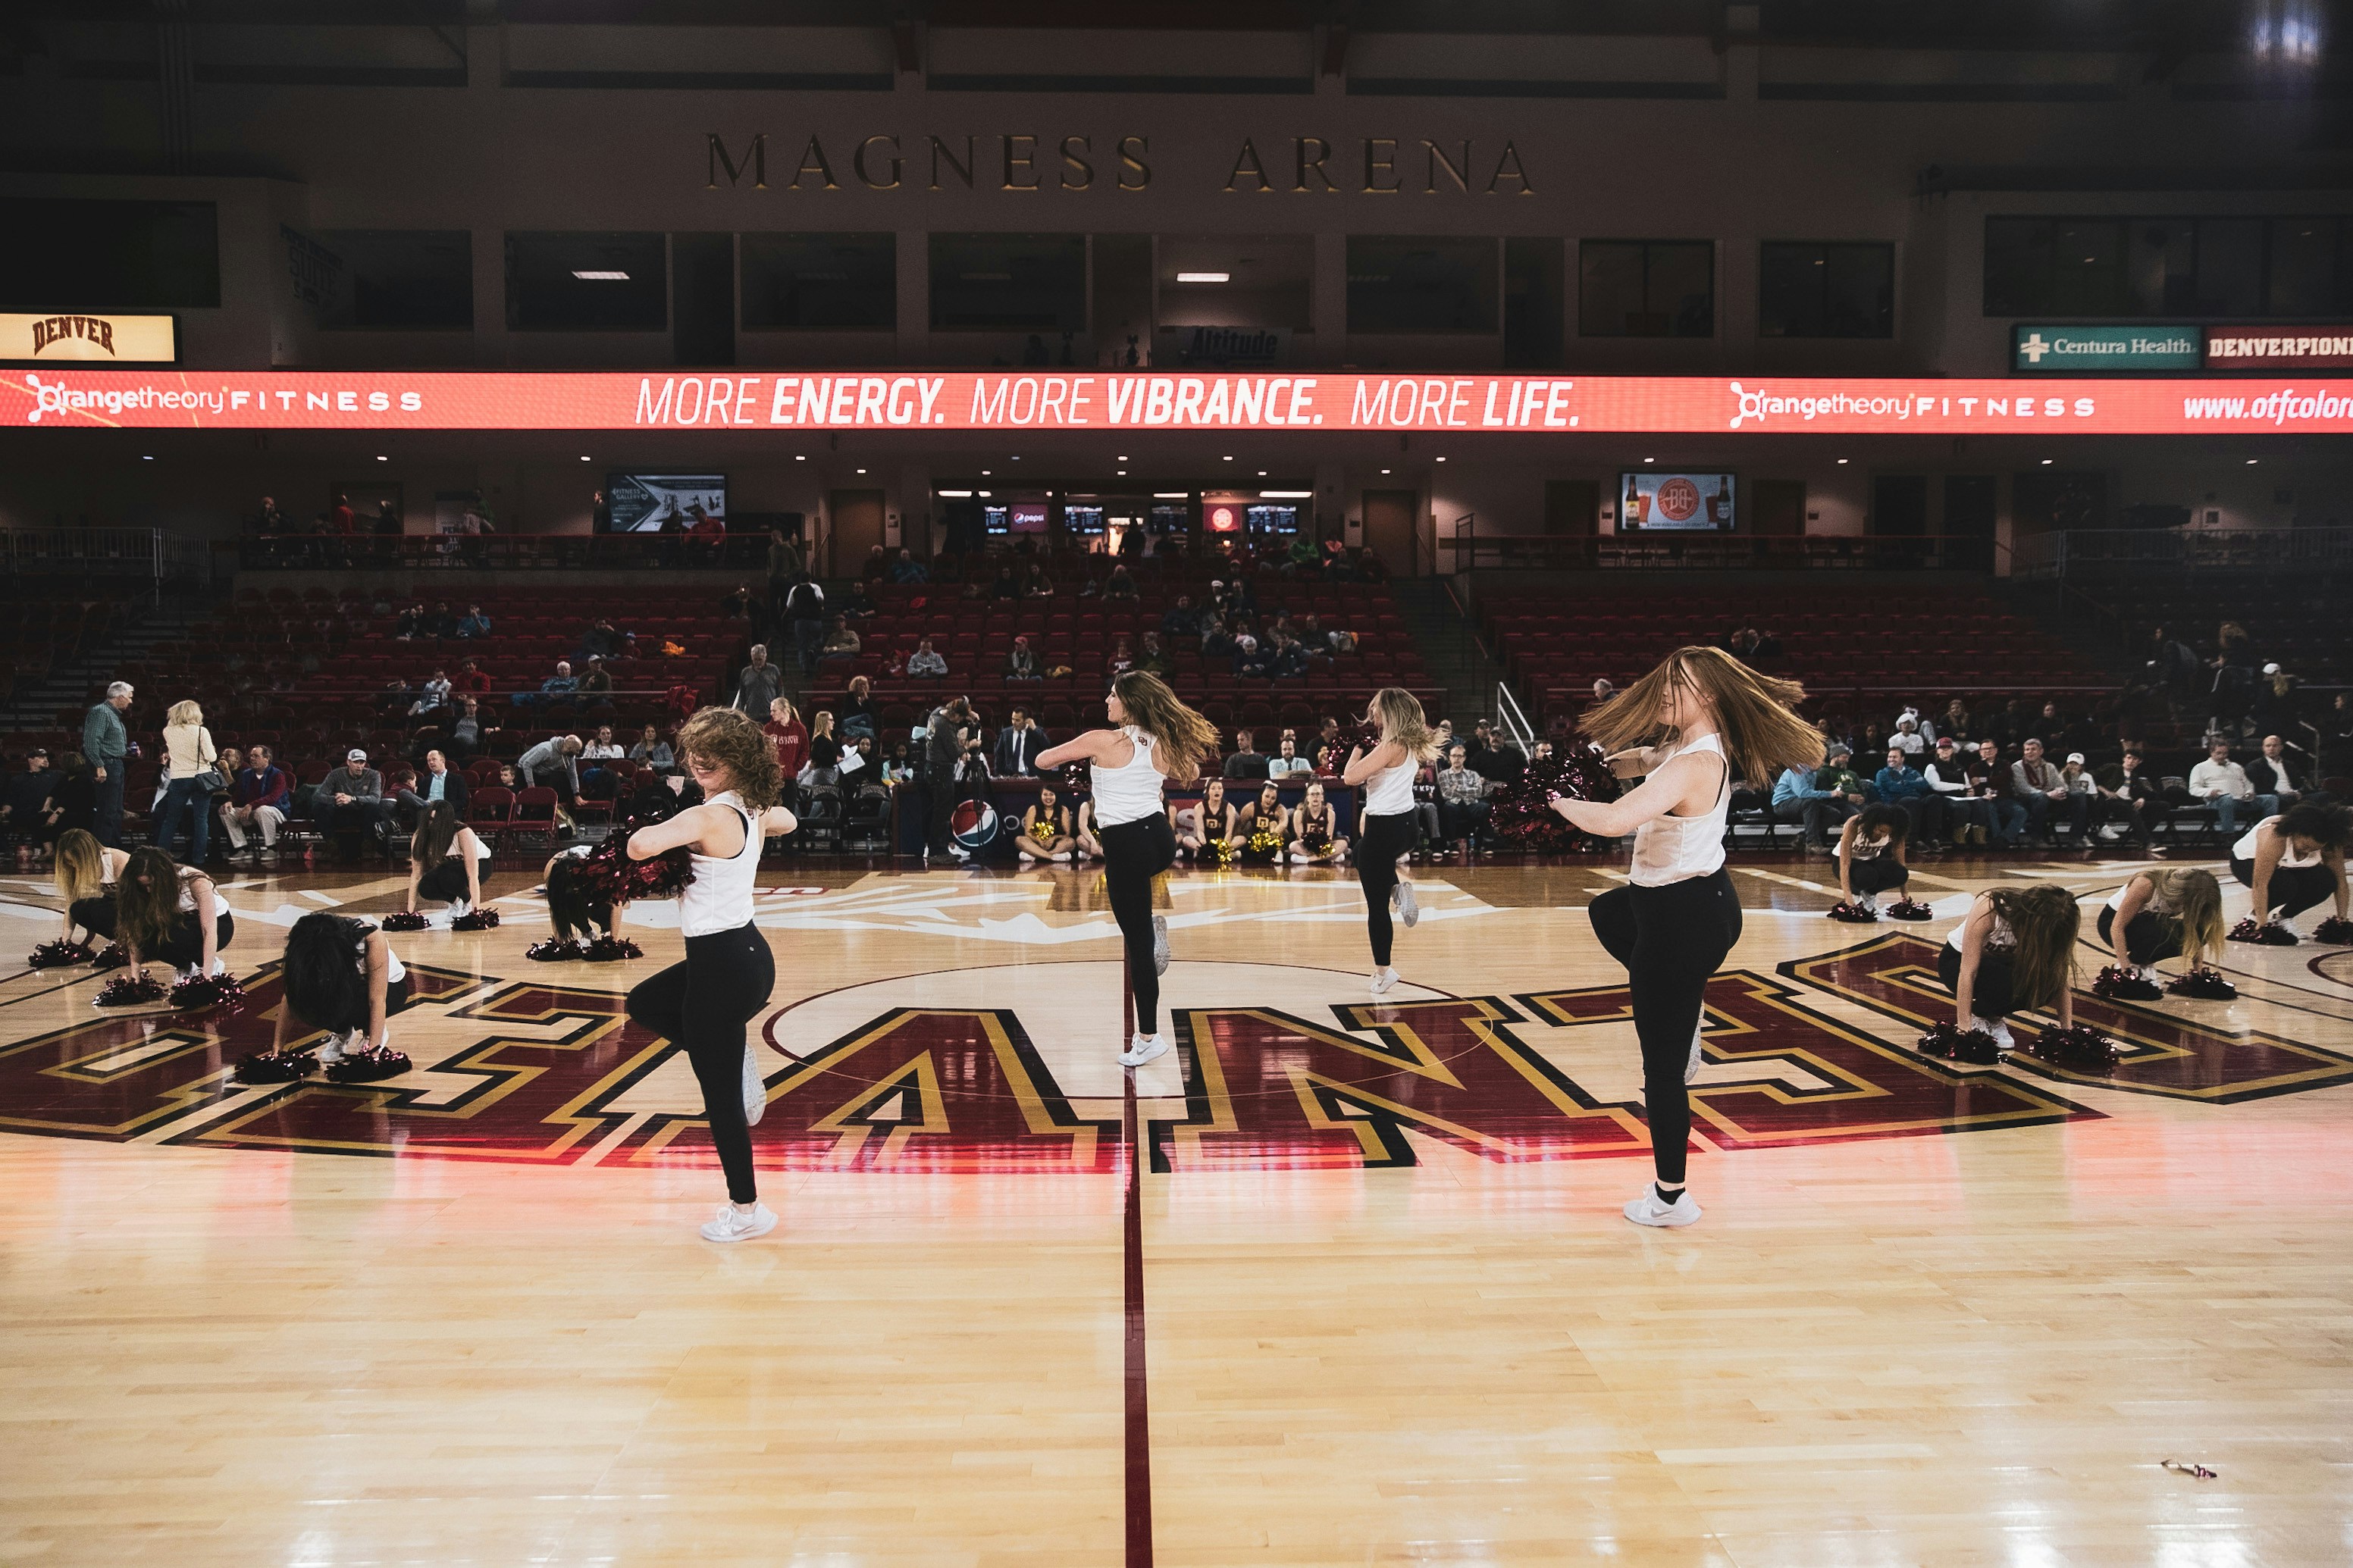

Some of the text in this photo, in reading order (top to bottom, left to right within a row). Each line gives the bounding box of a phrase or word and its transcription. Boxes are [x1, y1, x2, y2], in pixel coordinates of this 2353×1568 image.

[703, 133, 1540, 196] MAGNESS ARENA
[33, 316, 115, 358] DENVER
[1191, 327, 1278, 355] Altitude
[2054, 337, 2192, 355] Centura Health
[2208, 337, 2353, 357] DENVERPION
[230, 390, 423, 413] FITNESS
[634, 377, 1579, 427] MORE ENERGY. MORE VIBRANCE. MORE LIFE.
[1916, 397, 2097, 418] FITNESS
[2183, 389, 2353, 426] www.otfcolor
[1024, 514, 1045, 523] pepsi
